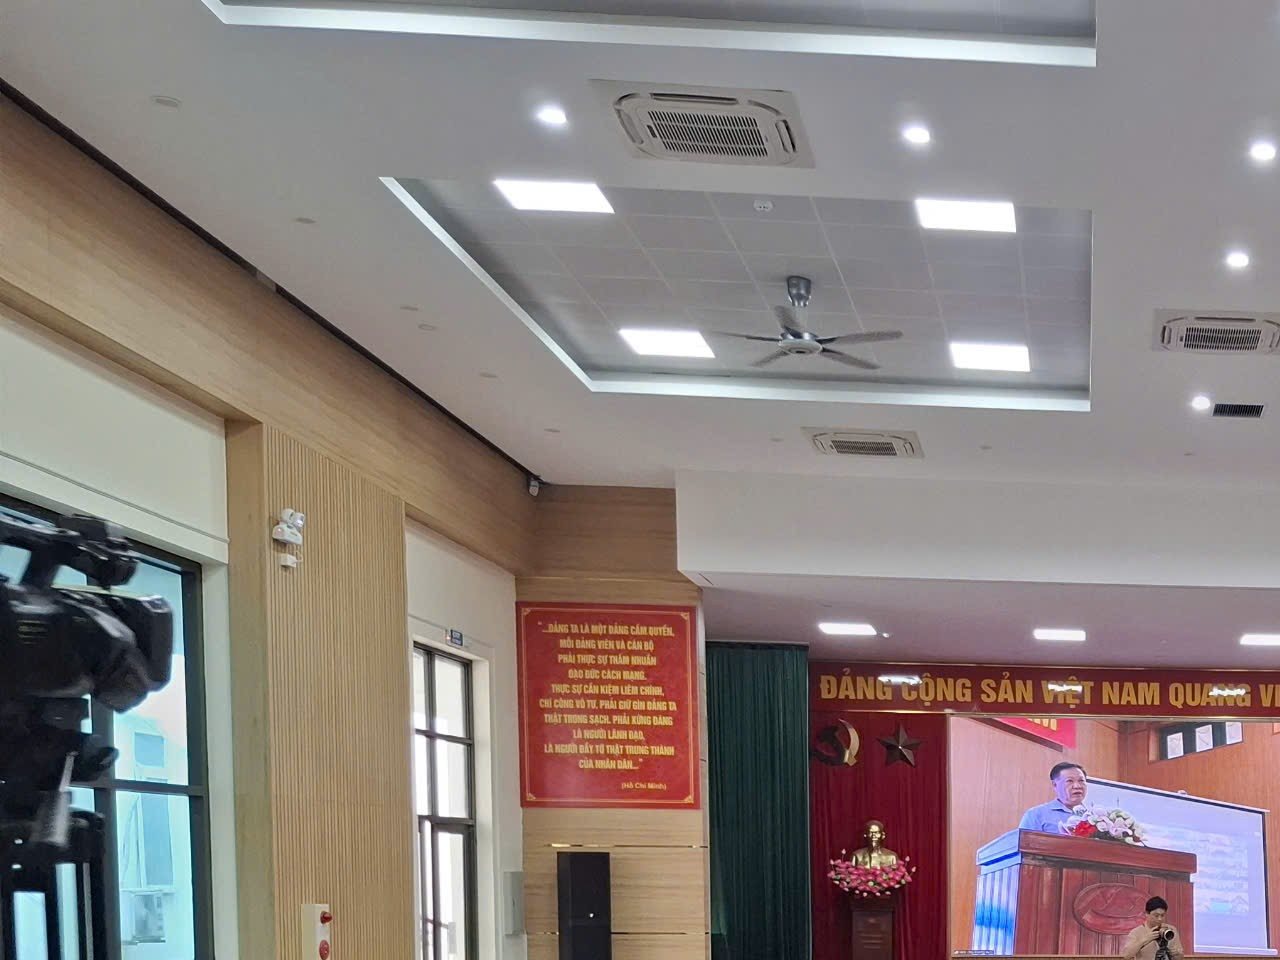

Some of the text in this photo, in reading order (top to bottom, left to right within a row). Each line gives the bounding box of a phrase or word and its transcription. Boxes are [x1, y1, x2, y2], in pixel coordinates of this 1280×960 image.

[820, 668, 892, 700] ĐẢNG
[902, 673, 971, 706] CỘNG
[981, 672, 1033, 703] SẢN
[1041, 676, 1094, 708] VIỆT
[1103, 682, 1160, 705] NAM
[1169, 683, 1251, 708] QUANG
